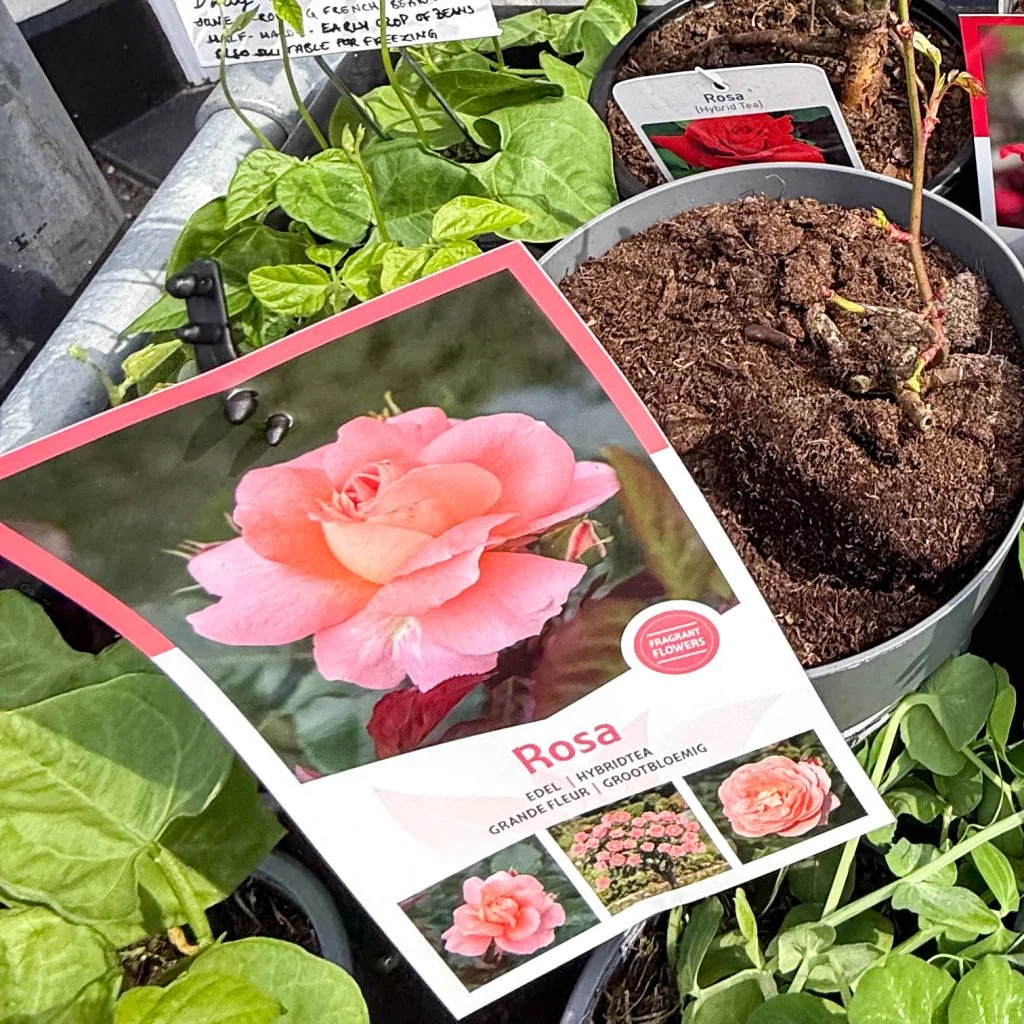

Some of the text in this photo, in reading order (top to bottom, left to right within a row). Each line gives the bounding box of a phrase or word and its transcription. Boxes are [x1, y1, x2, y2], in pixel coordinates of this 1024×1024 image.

[321, 20, 370, 34] EARLY
[415, 10, 431, 22] OF
[432, 5, 476, 19] BEANS
[322, 1, 380, 16] FRENCH
[703, 91, 745, 104] Rosa
[649, 627, 701, 648] FRAGRANT
[652, 637, 706, 659] FLOWERS
[511, 723, 622, 775] Rosa
[525, 747, 653, 802] EDEL HYBRIDTEA
[488, 742, 708, 836] GRANDE FLEUR GROOTBLOEMIG
